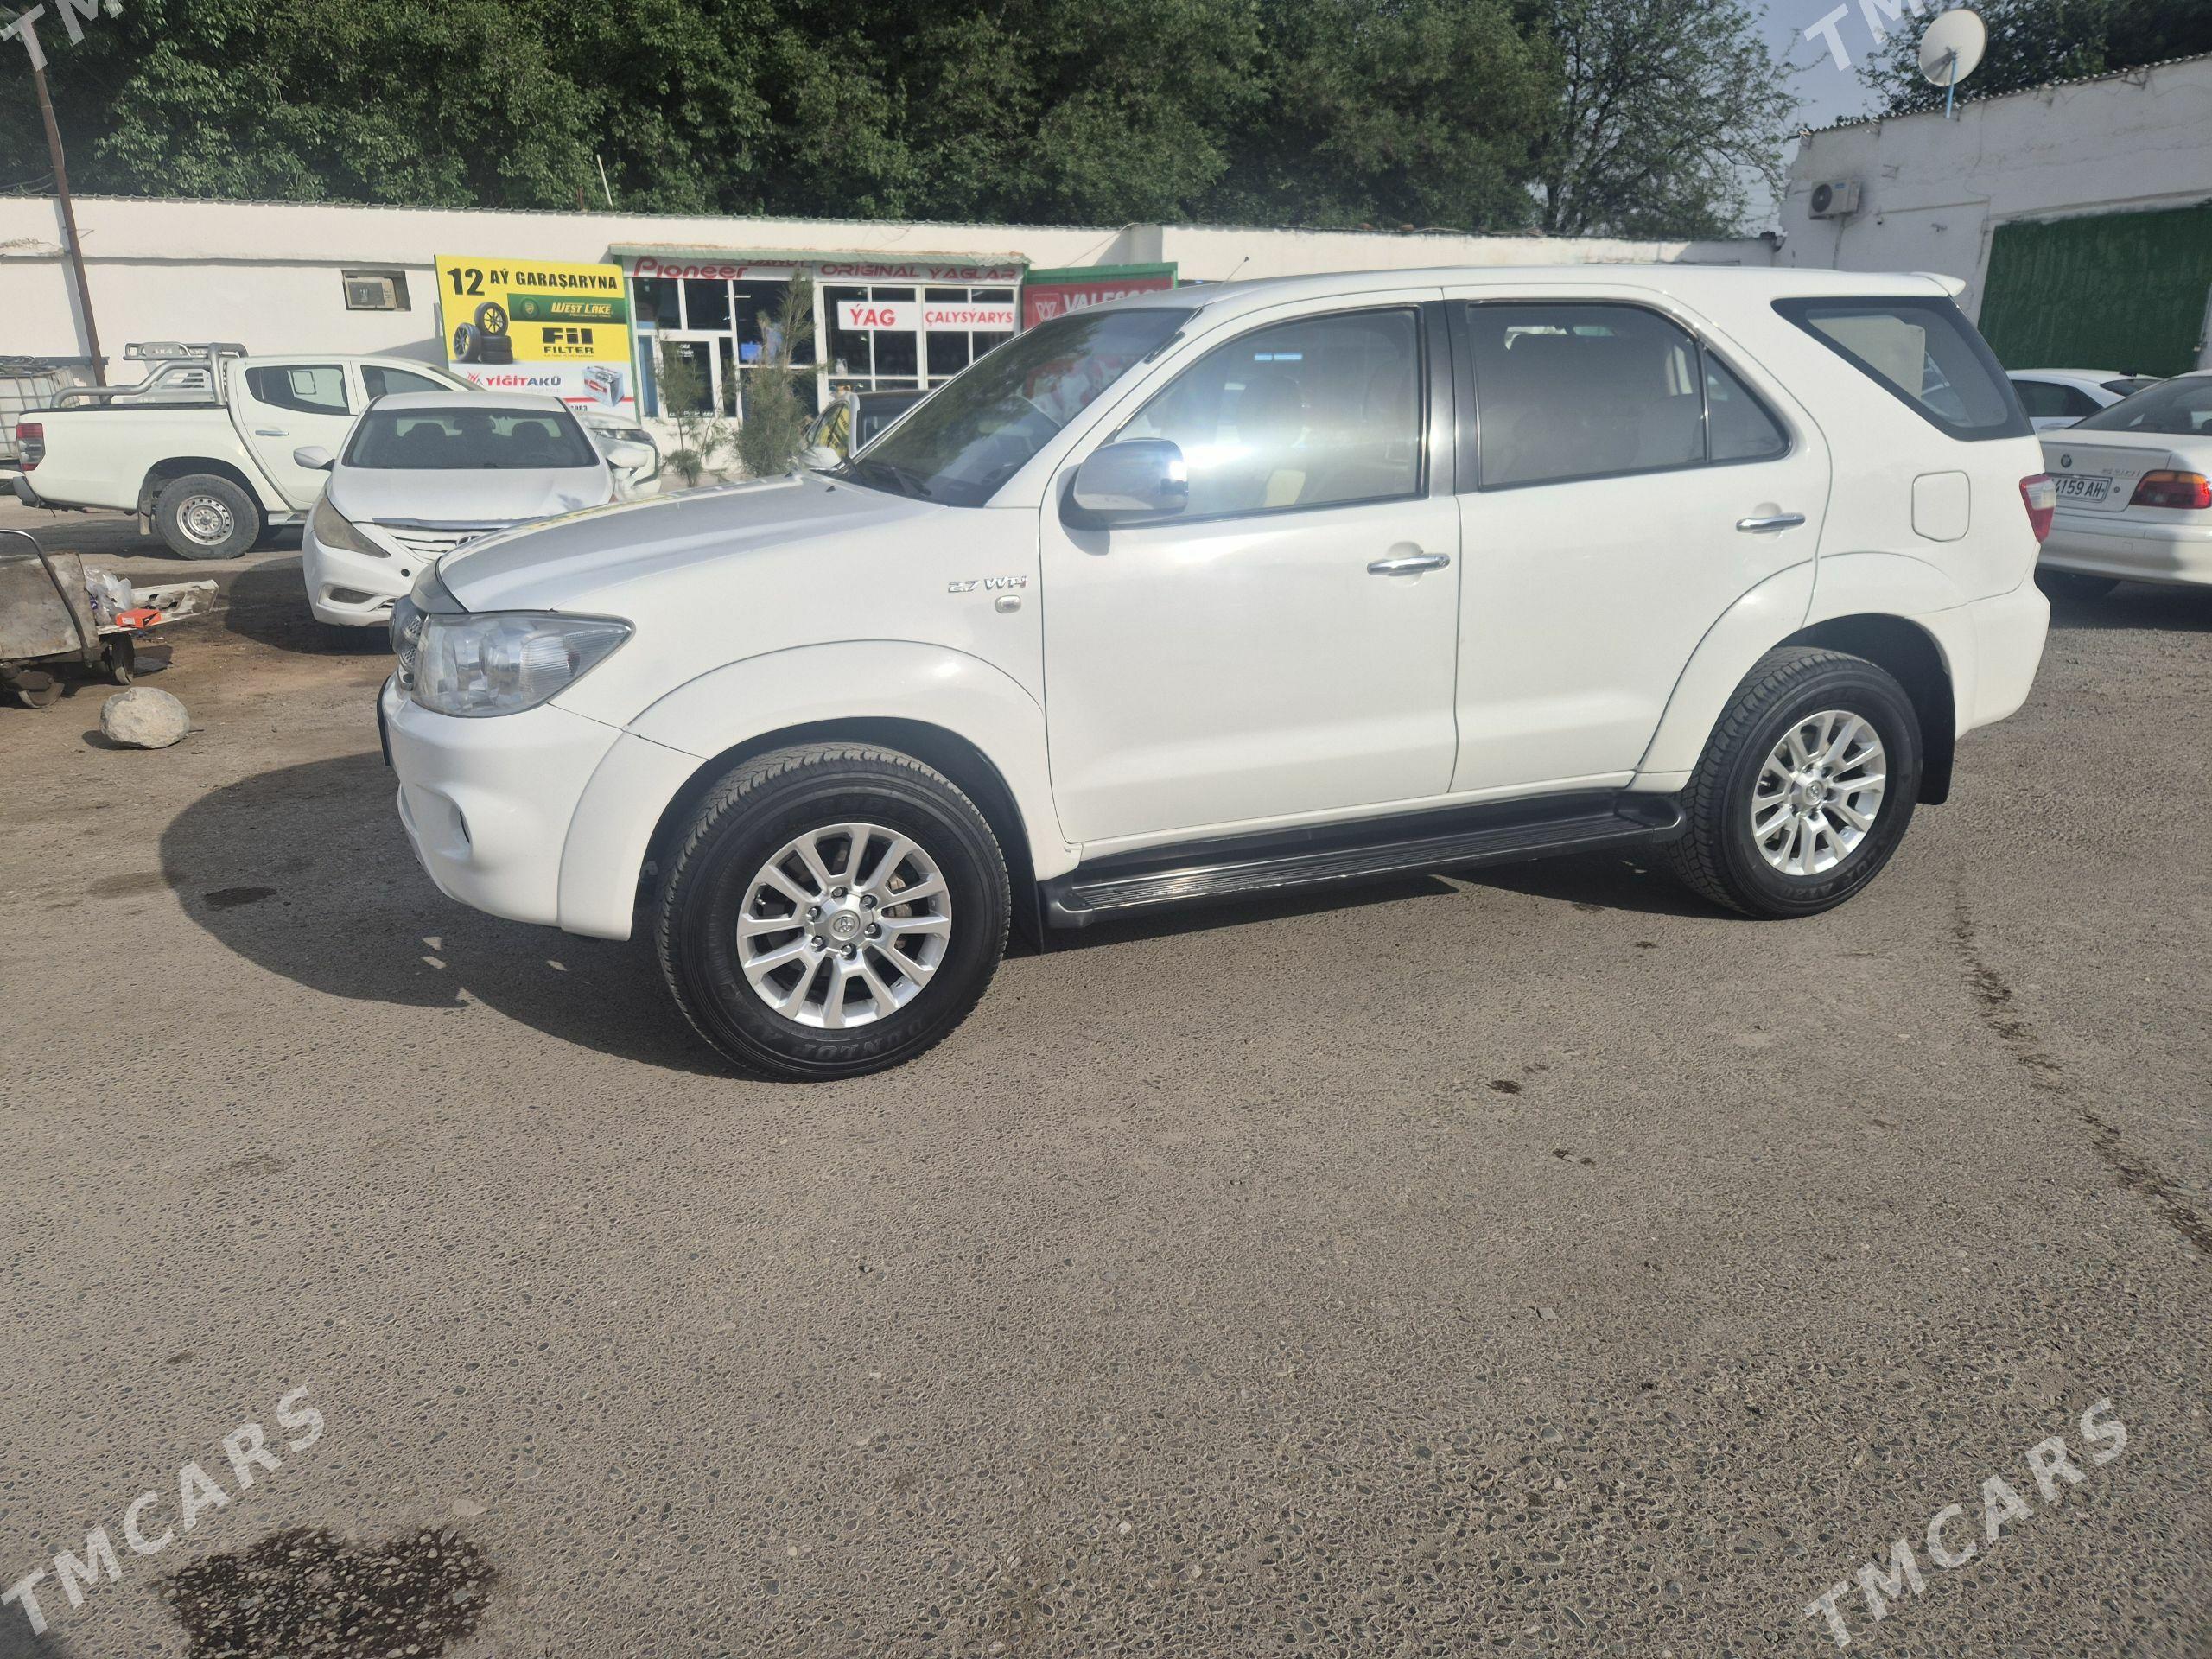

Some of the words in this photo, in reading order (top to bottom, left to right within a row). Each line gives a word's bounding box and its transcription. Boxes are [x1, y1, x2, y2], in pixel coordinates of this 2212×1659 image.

[633, 256, 748, 279] Pioneer
[821, 264, 920, 277] ORIGINAL
[447, 268, 485, 296] 12
[490, 268, 509, 285] AÝ
[515, 270, 618, 290] GARAŞARYNA
[550, 302, 582, 313] WEST
[584, 303, 612, 315] LAKE
[850, 303, 896, 327] ÝAG
[2084, 482, 2103, 498] AH
